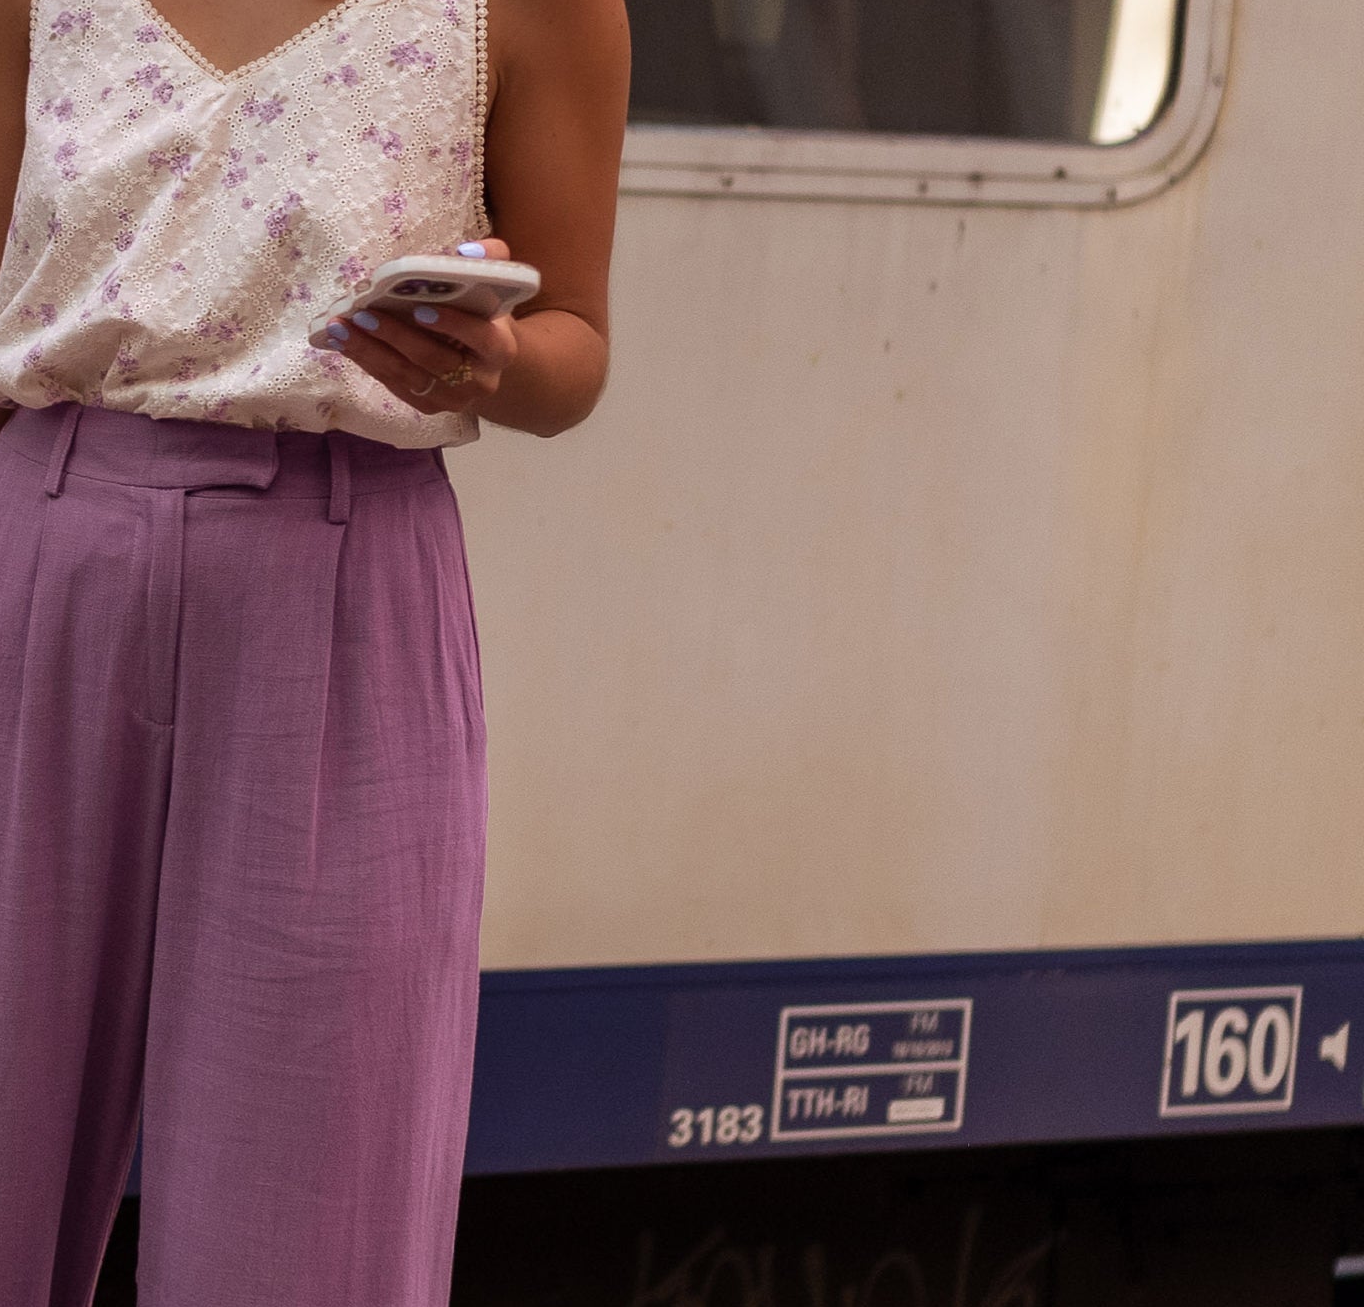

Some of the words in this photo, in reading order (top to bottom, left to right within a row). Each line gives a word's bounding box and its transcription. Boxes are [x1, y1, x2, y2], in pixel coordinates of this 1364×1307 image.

[789, 1024, 871, 1059] GH-RG
[1175, 1005, 1291, 1098] 160
[669, 1104, 764, 1148] 3183
